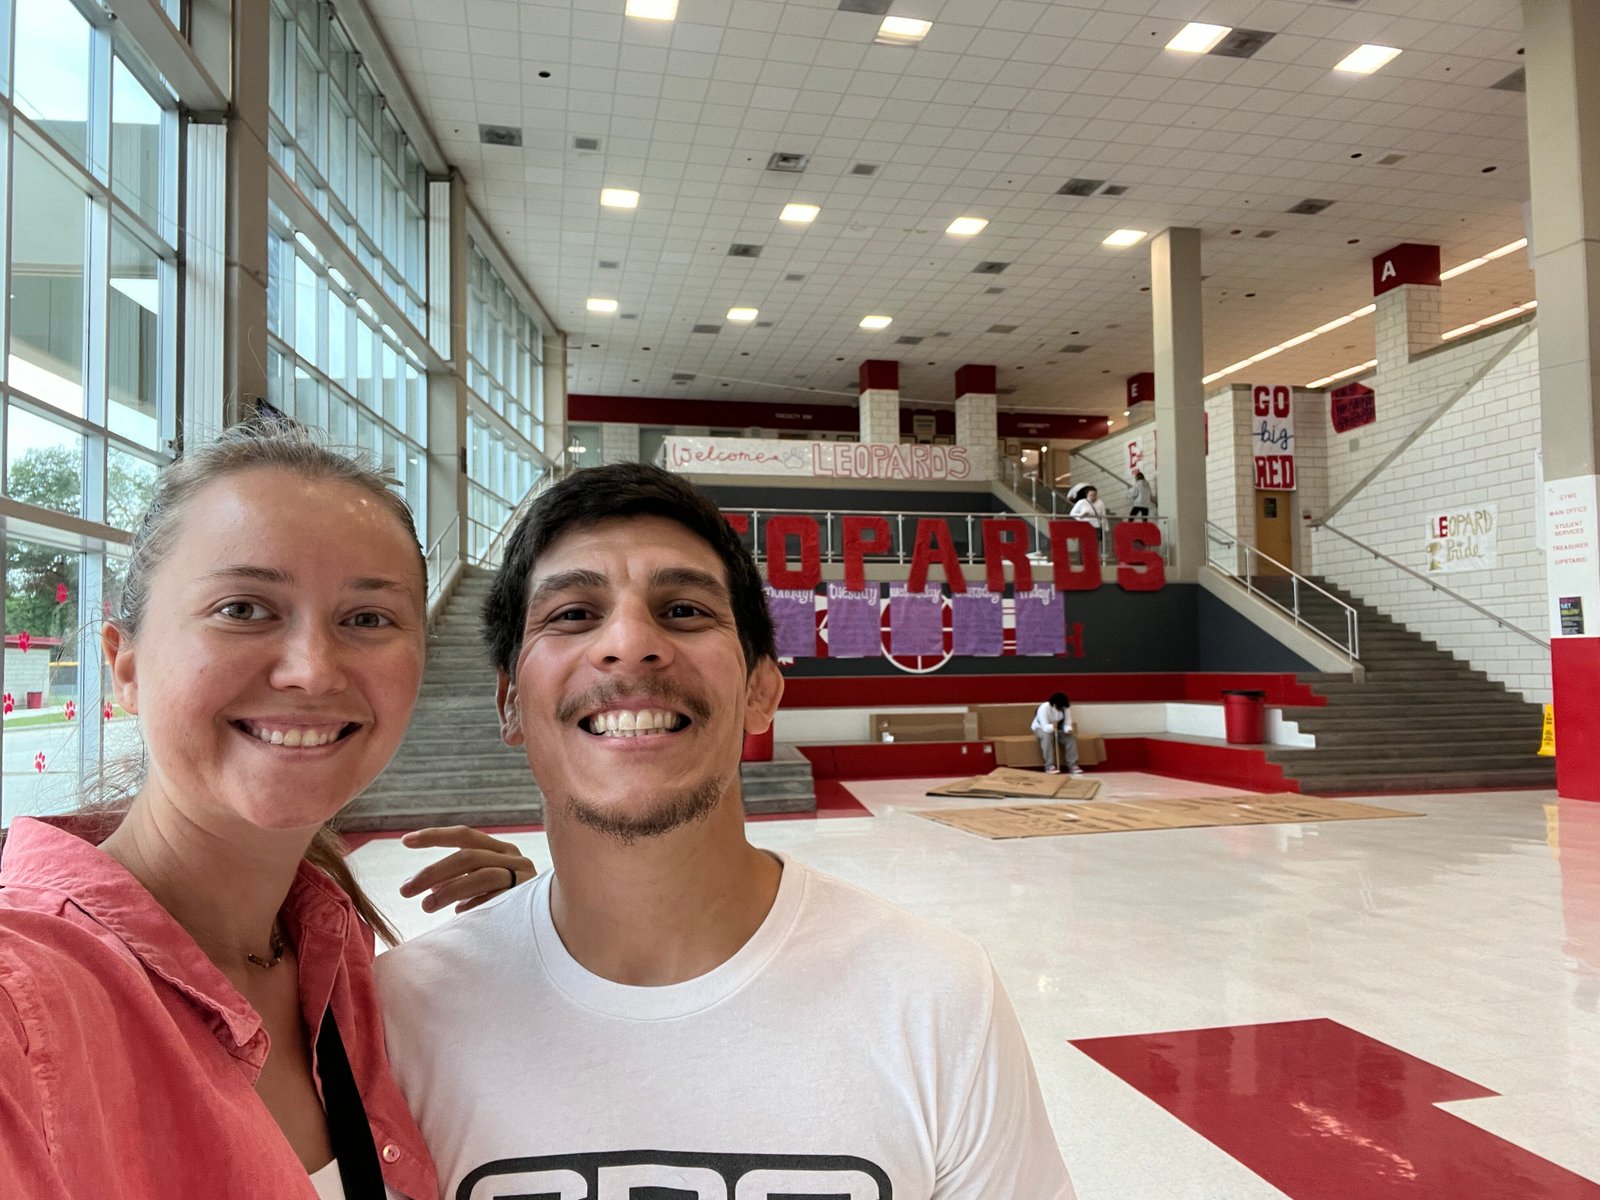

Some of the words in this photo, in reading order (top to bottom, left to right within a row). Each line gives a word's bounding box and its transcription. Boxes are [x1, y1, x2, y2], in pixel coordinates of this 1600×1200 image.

[1381, 260, 1396, 282] A
[1131, 383, 1139, 398] E
[1254, 386, 1290, 418] GO
[1252, 420, 1294, 450] big
[672, 443, 774, 467] Welcome
[812, 442, 972, 480] LEOPARDS
[1254, 455, 1295, 489] RED
[1431, 510, 1493, 539] LEOPARD
[1549, 509, 1565, 517] MAIN
[1566, 506, 1588, 514] OFFICE
[1554, 528, 1584, 537] SERVICES
[1555, 521, 1583, 530] STUDENT
[720, 513, 1166, 592] OPARDS
[1446, 536, 1485, 562] Pride
[1552, 542, 1589, 551] TREASURER
